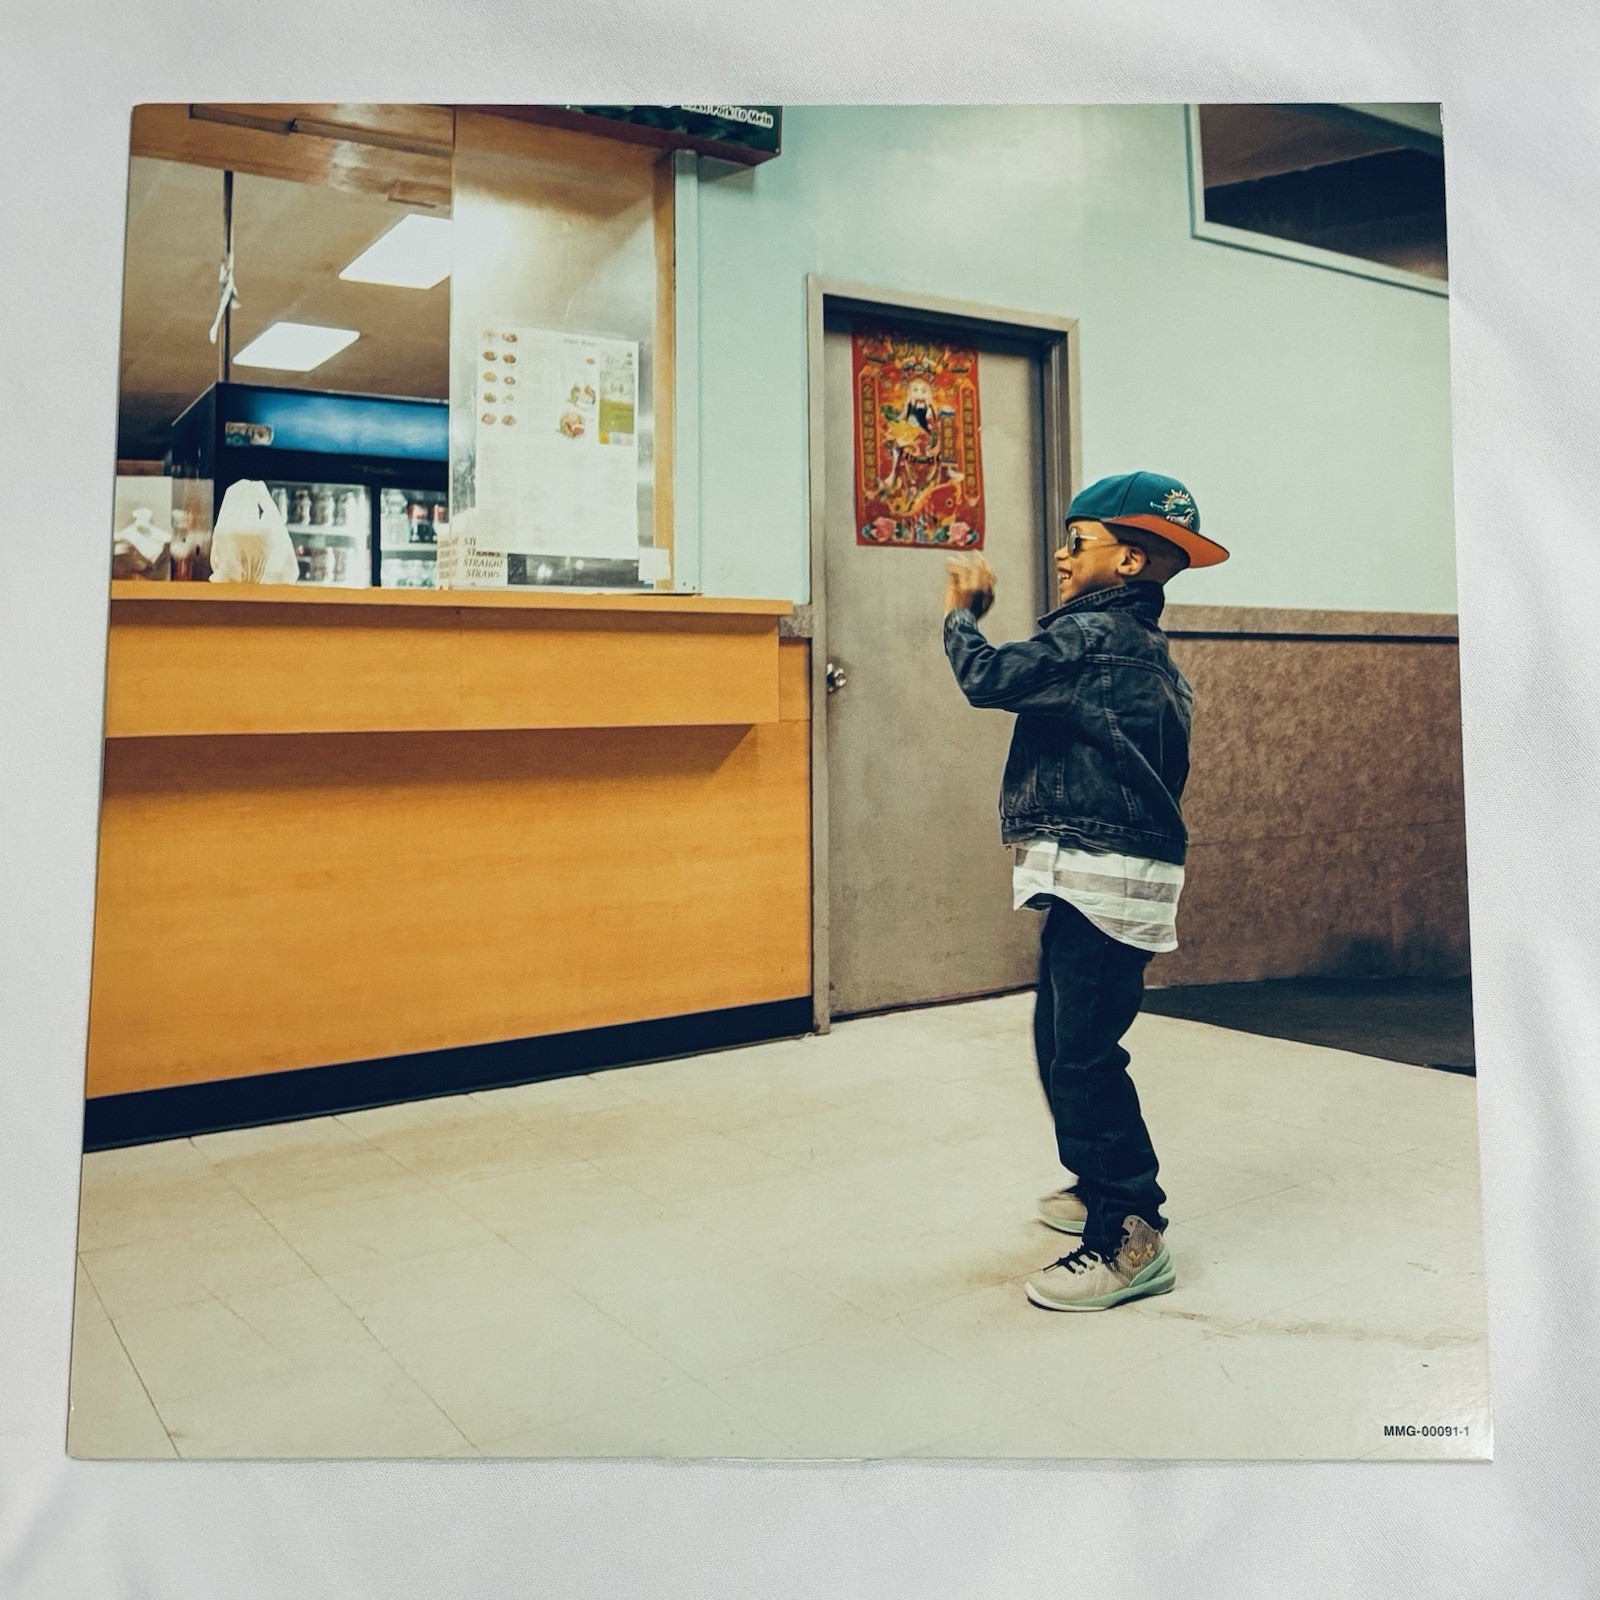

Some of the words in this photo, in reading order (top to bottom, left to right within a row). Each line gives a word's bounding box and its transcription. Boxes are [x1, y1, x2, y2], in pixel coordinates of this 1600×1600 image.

[748, 111, 772, 126] Mein
[466, 569, 501, 578] STRAWS
[1384, 1425, 1469, 1437] MMG-00091-1
